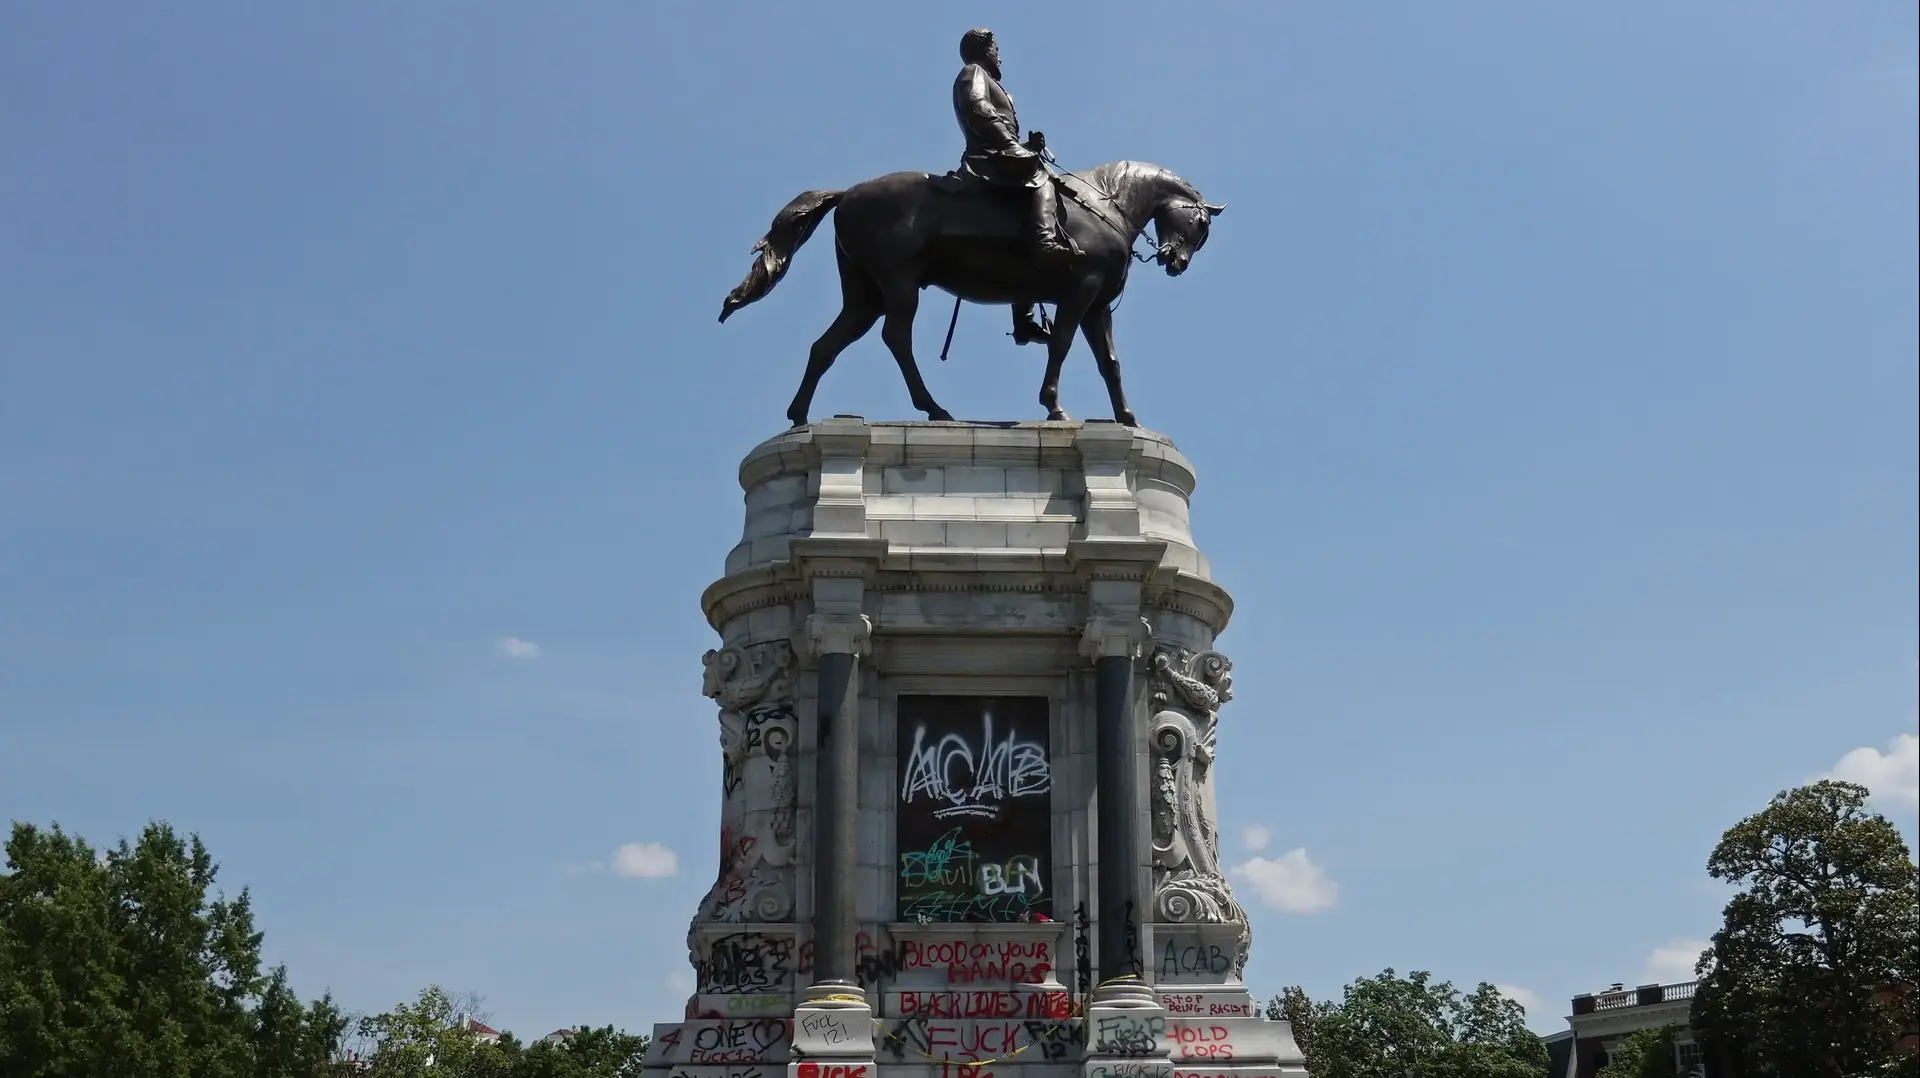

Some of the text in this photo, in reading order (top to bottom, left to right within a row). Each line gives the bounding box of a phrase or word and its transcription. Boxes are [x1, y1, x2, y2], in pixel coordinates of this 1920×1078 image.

[902, 712, 1052, 803] ACAB
[903, 941, 967, 970] BLOOD
[1161, 939, 1230, 978] ACAB
[948, 961, 1052, 984] HANDS
[900, 991, 961, 1019] BLACK
[695, 1022, 753, 1051] ONE
[927, 1022, 1021, 1055] FUCK
[1023, 1020, 1084, 1045] FUCK
[1181, 1044, 1234, 1061] COPS
